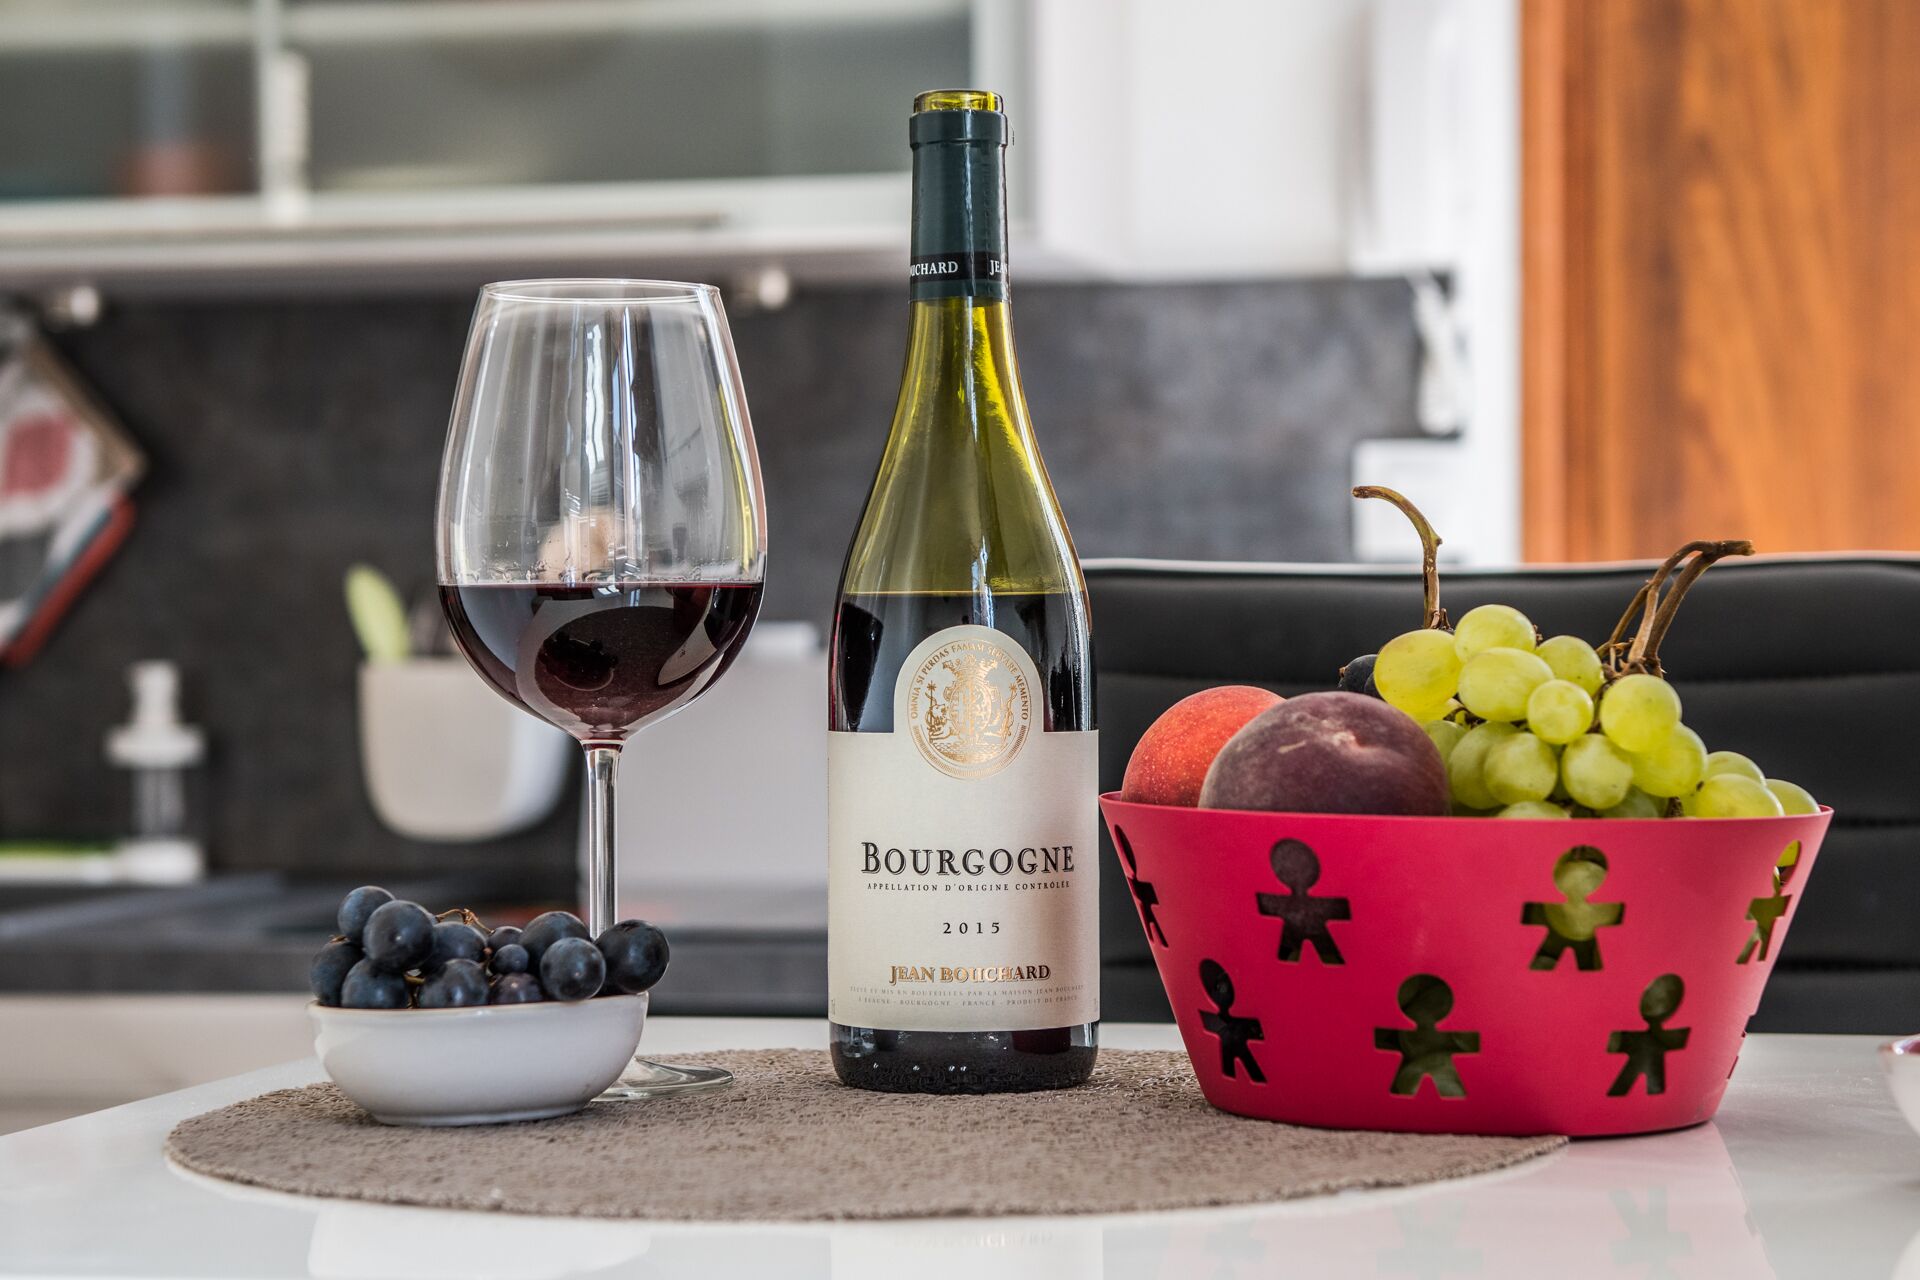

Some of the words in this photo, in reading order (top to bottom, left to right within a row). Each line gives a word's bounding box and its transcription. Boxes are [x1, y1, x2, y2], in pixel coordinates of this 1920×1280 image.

[911, 687, 921, 720] OMNIA
[916, 675, 925, 686] SI
[922, 648, 950, 675] PERDAS
[1014, 674, 1029, 720] MEMENTO
[861, 842, 1075, 876] BOURGOGNE
[867, 882, 938, 892] APPELLATION
[945, 882, 1009, 892] D'ORIGINE
[943, 922, 1000, 934] 2015
[889, 965, 936, 986] JEAN
[940, 965, 1052, 983] BOUCHARD
[1036, 987, 1053, 995] JEAN
[900, 999, 950, 1007] BOURGOGNE
